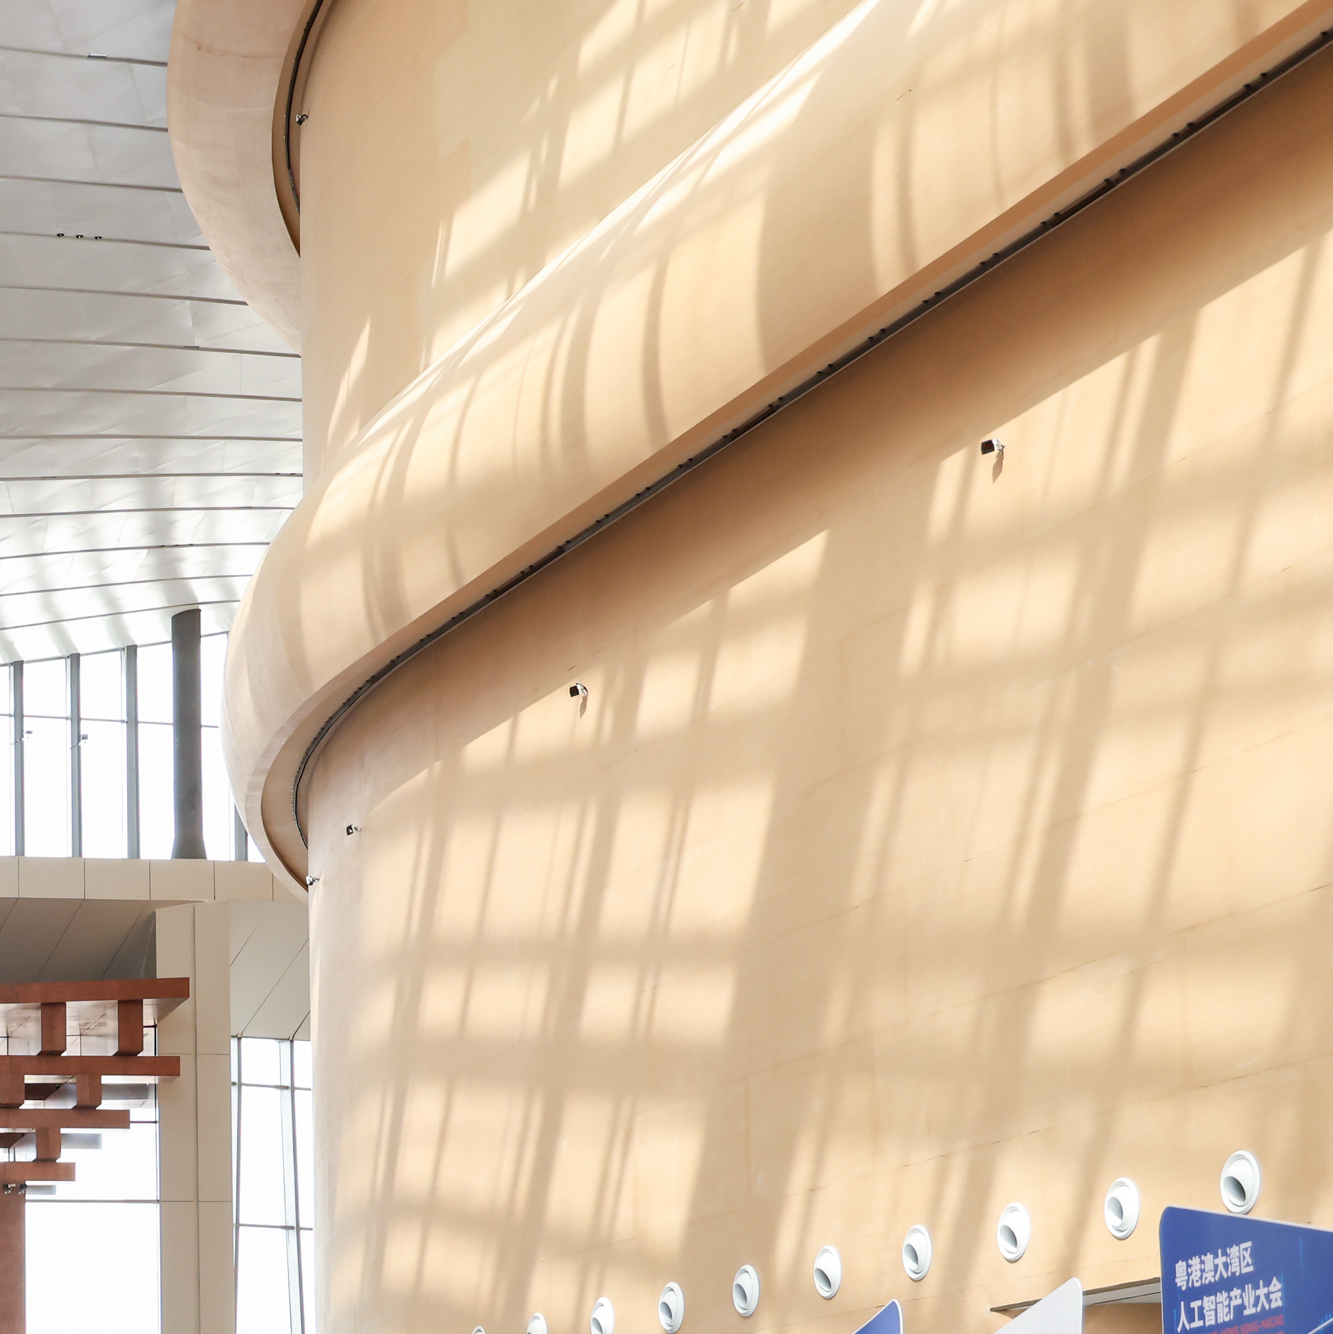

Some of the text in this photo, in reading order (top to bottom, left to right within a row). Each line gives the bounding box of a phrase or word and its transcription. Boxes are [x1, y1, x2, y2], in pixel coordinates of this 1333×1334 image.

[1175, 1241, 1254, 1291] 粤港澳大湾区
[1176, 1276, 1283, 1334] 人工智能产业大会
